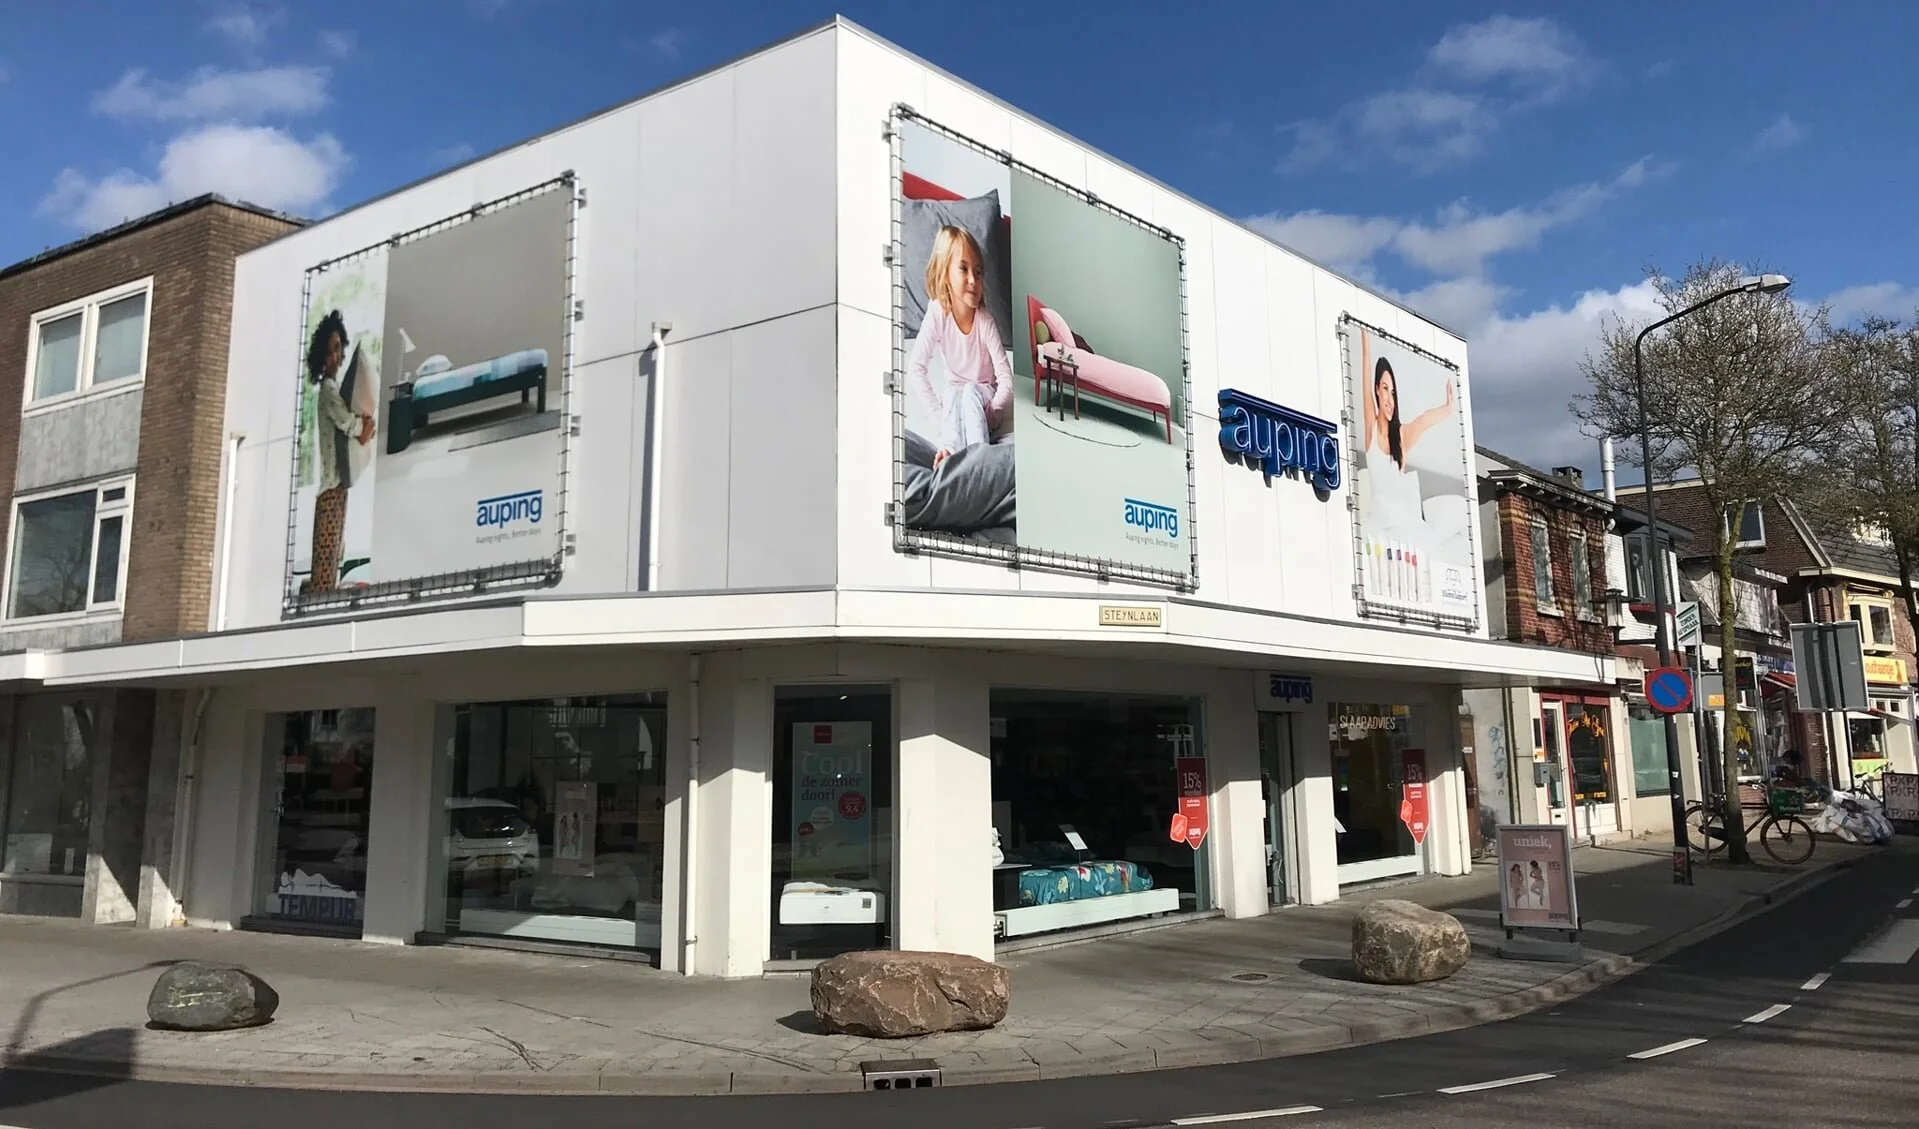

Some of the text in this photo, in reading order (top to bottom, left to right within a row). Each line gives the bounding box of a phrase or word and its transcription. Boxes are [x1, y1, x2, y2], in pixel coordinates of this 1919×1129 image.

[1218, 403, 1340, 490] auping
[477, 496, 542, 528] auping
[1125, 504, 1177, 538] auping
[1104, 609, 1159, 621] STEYNLAAN
[1271, 679, 1313, 704] auping
[801, 750, 864, 775] Cool
[1407, 763, 1423, 780] 15%
[801, 776, 862, 788] de zomer
[1183, 771, 1201, 789] 15%
[801, 788, 835, 801] door!
[1513, 835, 1552, 849] uniek,
[278, 893, 357, 922] TEMPUR
